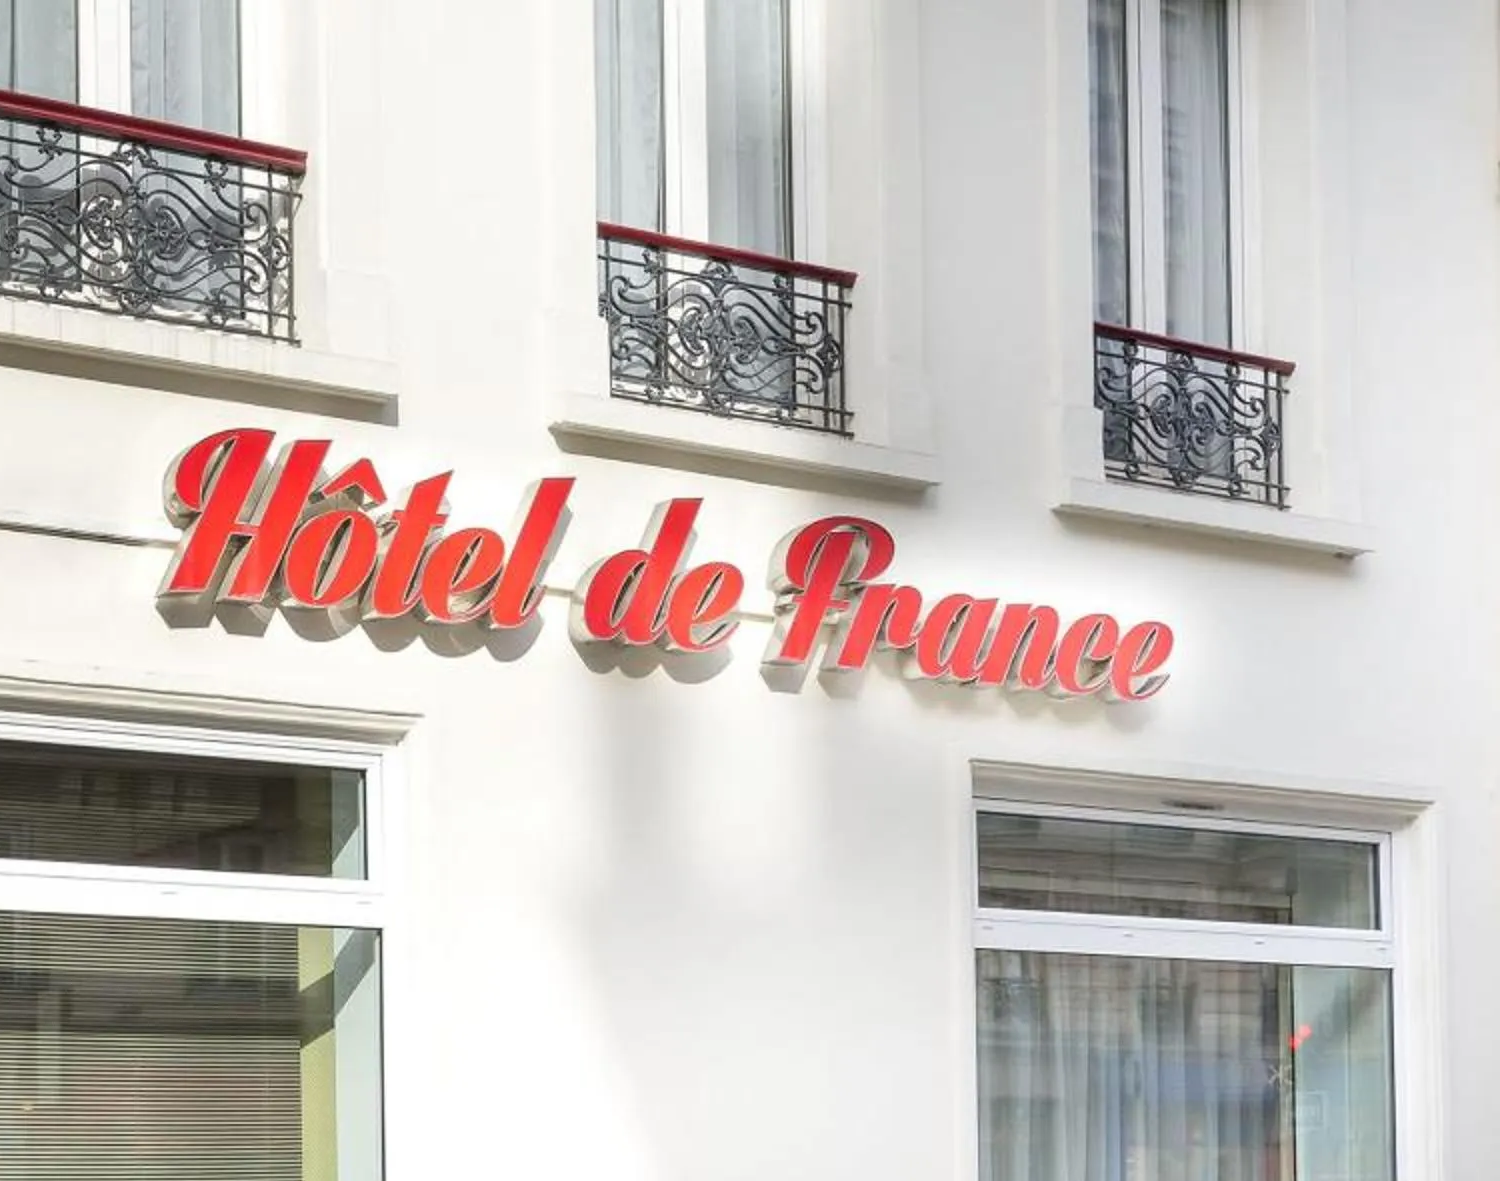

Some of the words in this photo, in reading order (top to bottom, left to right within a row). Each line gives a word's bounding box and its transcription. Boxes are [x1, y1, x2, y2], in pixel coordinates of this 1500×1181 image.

[166, 427, 577, 630] Hôtel
[583, 496, 745, 650] de
[780, 515, 1176, 703] France
